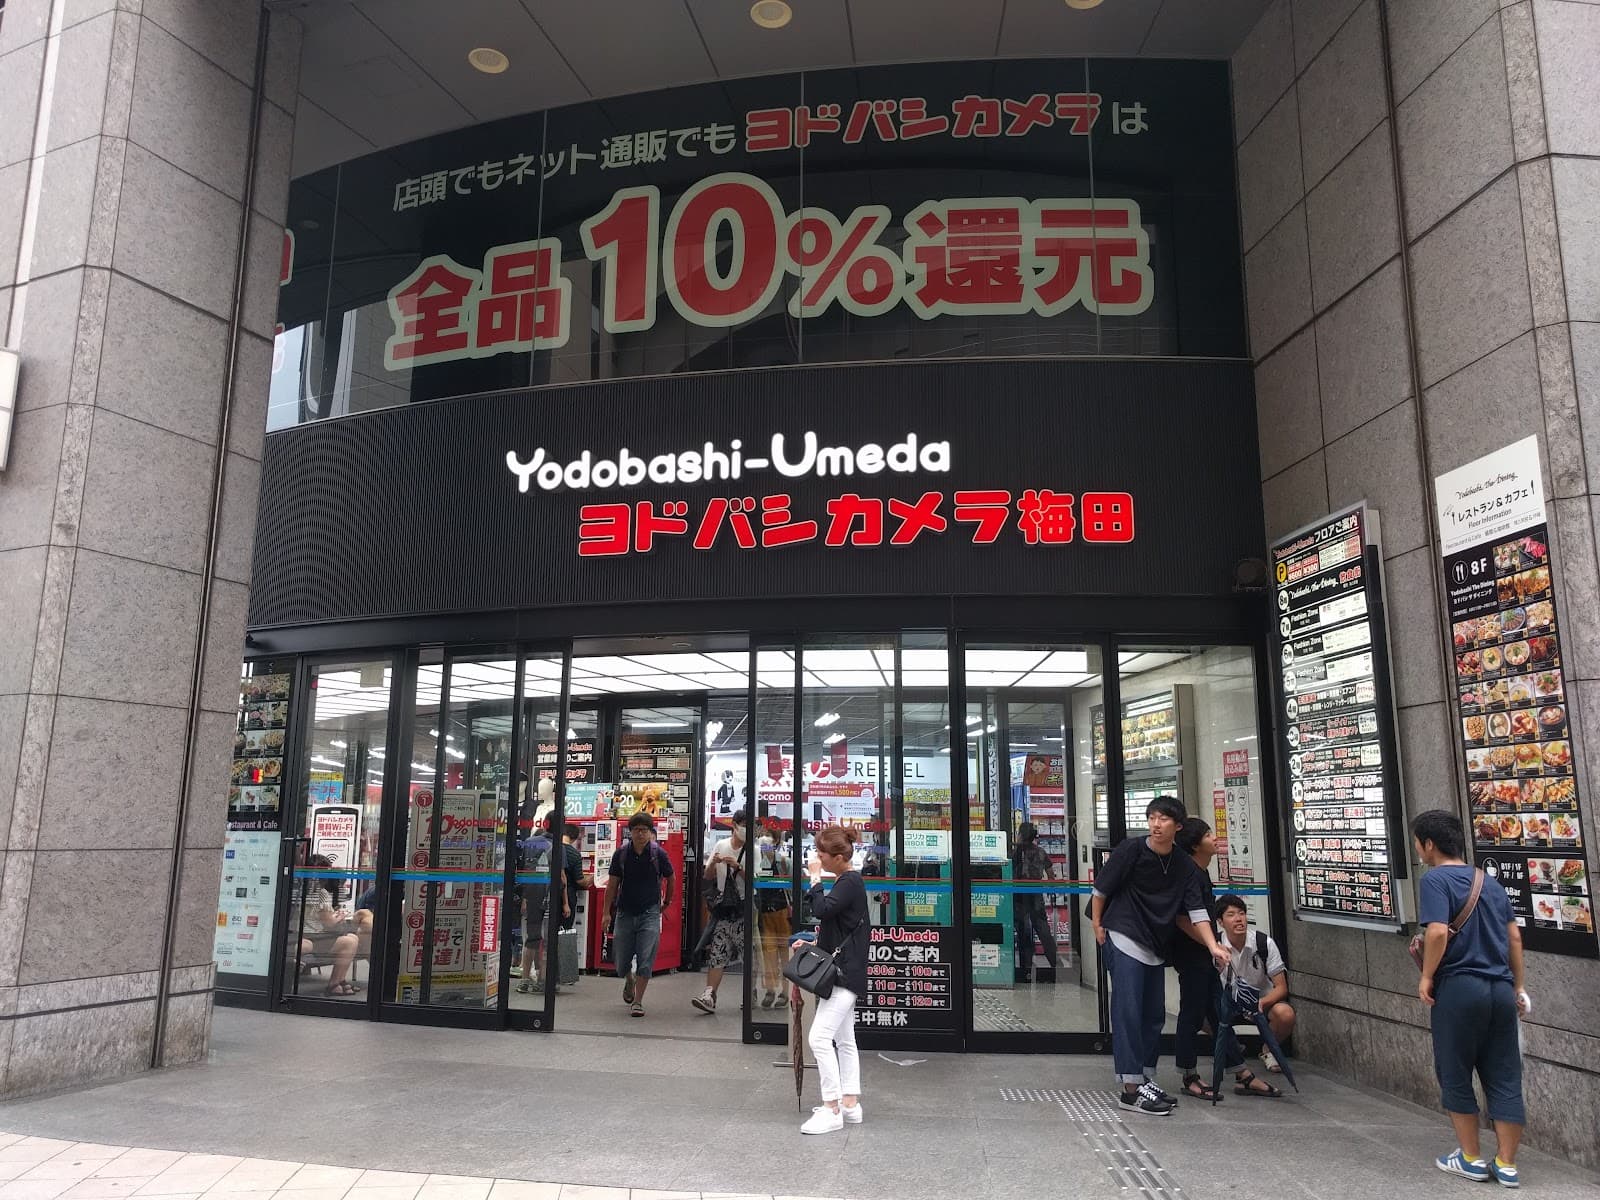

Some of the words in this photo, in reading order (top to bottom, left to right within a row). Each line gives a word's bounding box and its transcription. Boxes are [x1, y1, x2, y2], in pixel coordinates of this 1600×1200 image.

[505, 431, 951, 493] Yodobashi-Umeda
[578, 488, 1136, 557] ヨドバシカメラ梅田
[1471, 558, 1487, 575] 8F
[757, 792, 791, 801] ocomo
[227, 820, 257, 829] estaurant
[263, 820, 278, 829] Cafe
[869, 926, 939, 943] hi-Umeda
